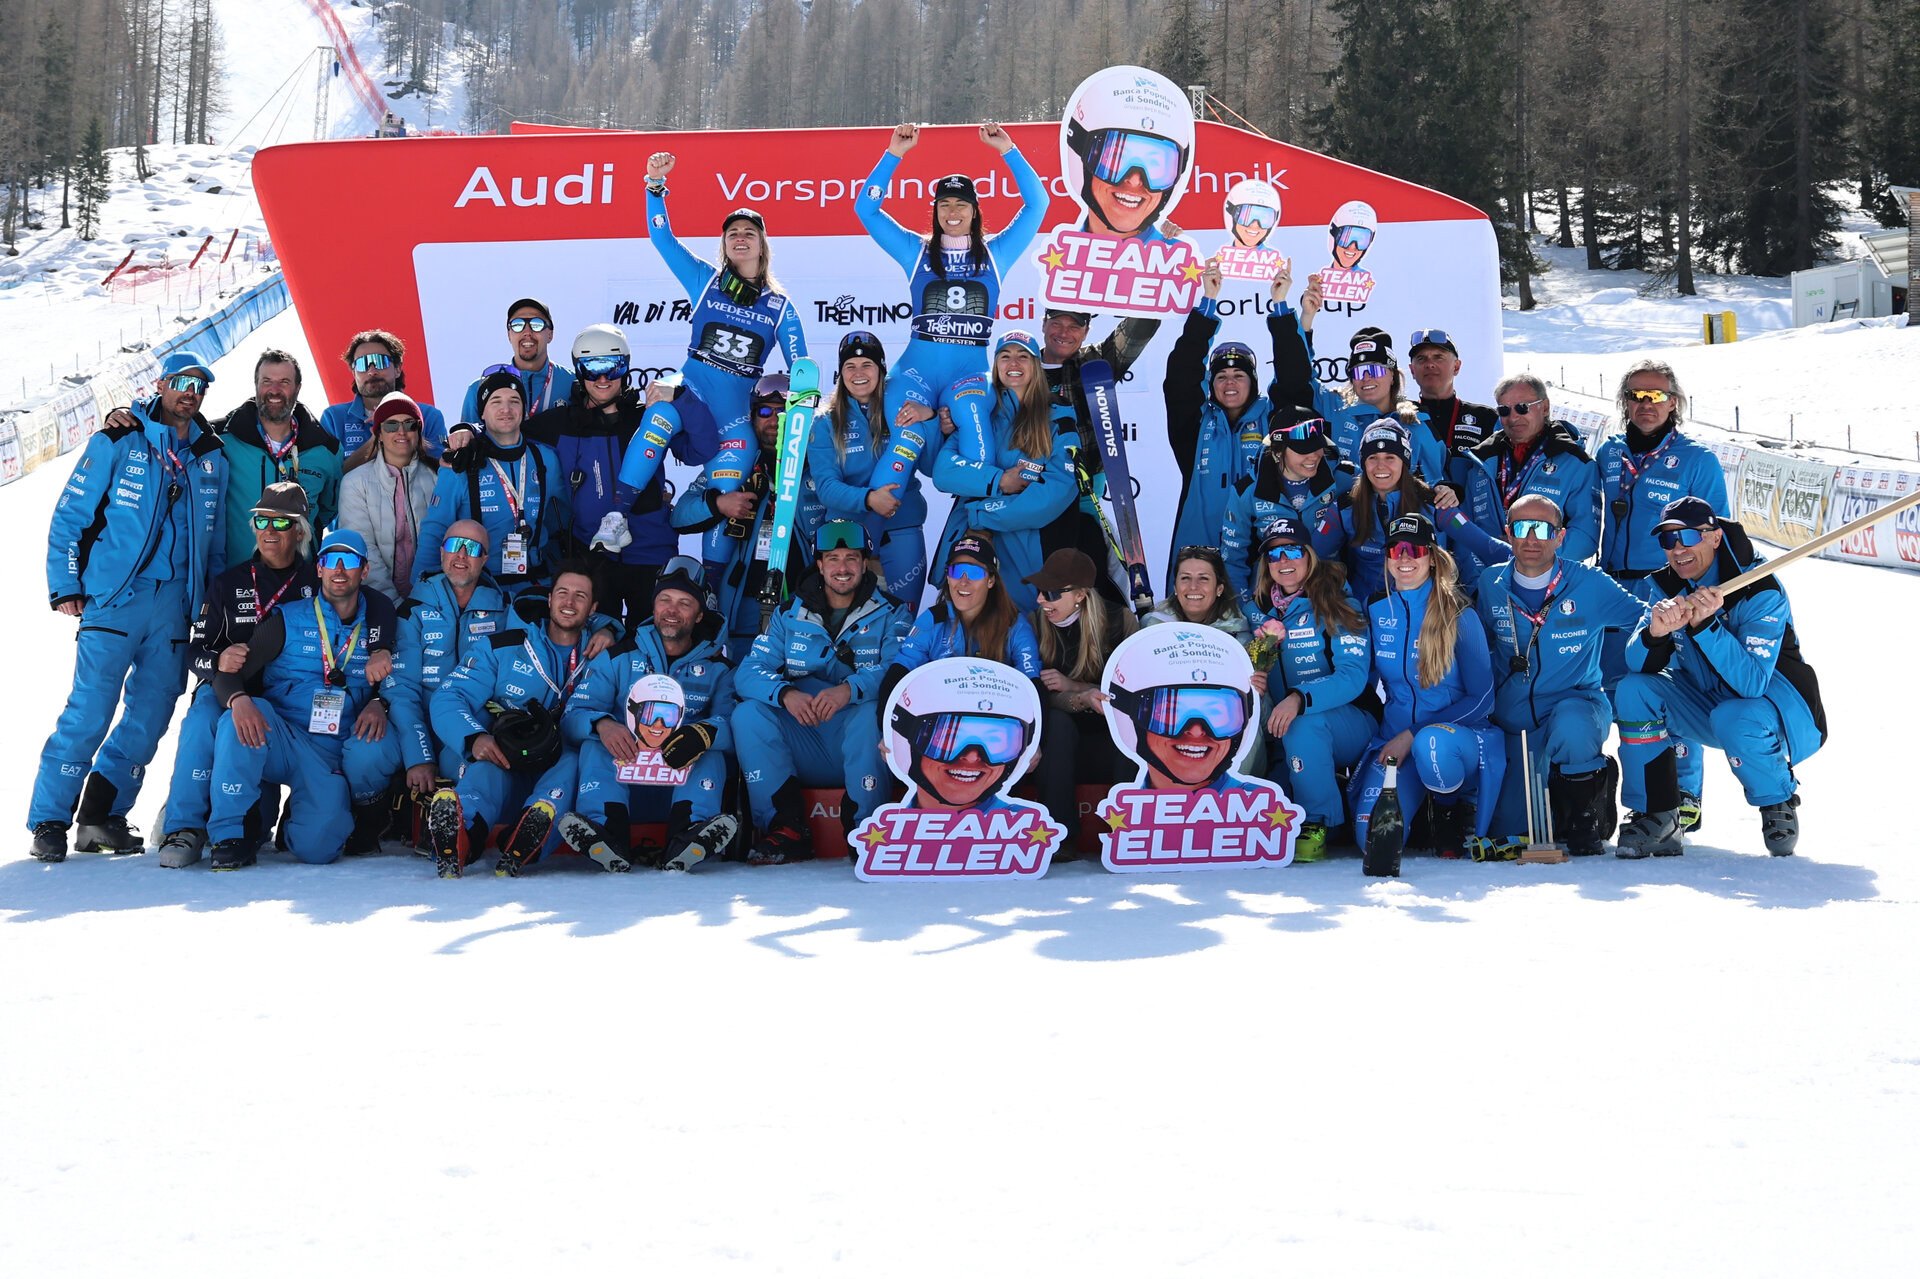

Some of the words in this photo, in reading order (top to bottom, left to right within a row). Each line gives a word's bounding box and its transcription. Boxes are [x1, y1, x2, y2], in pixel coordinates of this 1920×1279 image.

[1113, 88, 1141, 96] Banca
[1137, 96, 1170, 110] Sondrio
[454, 163, 615, 208] Audi
[1062, 235, 1187, 275] TEAM
[1222, 248, 1277, 265] TEAM
[1219, 263, 1277, 280] ELLEN
[1323, 269, 1369, 286] TEAM
[1053, 269, 1193, 309] ELLEN
[946, 286, 966, 309] 8
[613, 301, 640, 325] VAL
[669, 299, 693, 324] FA
[706, 299, 775, 326] VREDESTEIN
[814, 300, 914, 326] TRENTINO
[725, 314, 752, 325] TYRES
[926, 318, 983, 335] TRENTINO
[713, 328, 754, 359] 33
[932, 336, 976, 346] VREDESTEIN
[1094, 386, 1118, 457] SALOMON
[129, 450, 149, 461] EA7
[781, 412, 805, 502] HEAD
[1646, 478, 1679, 490] FALCONERI
[117, 488, 142, 501] FORST
[1648, 491, 1670, 501] enel
[1743, 478, 1774, 509] FORST
[985, 501, 1007, 512] EA7
[1256, 502, 1274, 511] EA7
[1781, 488, 1820, 520] FORST
[422, 610, 441, 619] EA7
[1378, 617, 1398, 627] EA7
[1340, 635, 1367, 647] FORST
[1552, 629, 1588, 639] FALCONERI
[1153, 643, 1184, 655] Banca
[1188, 641, 1229, 655] Popolare
[1288, 641, 1320, 649] FALCONERI
[1559, 643, 1582, 654] enel
[1746, 636, 1777, 648] FORST
[1168, 650, 1180, 658] di
[1183, 650, 1221, 659] Sondrio
[1295, 653, 1317, 663] enel
[513, 661, 534, 674] EA7
[944, 675, 976, 684] Banca
[979, 675, 1019, 689] Popolare
[972, 682, 1010, 693] Sondrio
[461, 712, 484, 731] Audi
[416, 731, 432, 761] Audi
[61, 764, 82, 775] EA7
[620, 766, 685, 782] ELLEN
[222, 783, 242, 793] EA7
[810, 802, 841, 818] Au
[1122, 793, 1270, 824] TEAM
[885, 813, 1034, 840] TEAM
[1116, 827, 1281, 859] ELLEN
[869, 843, 1040, 871] ELLEN
